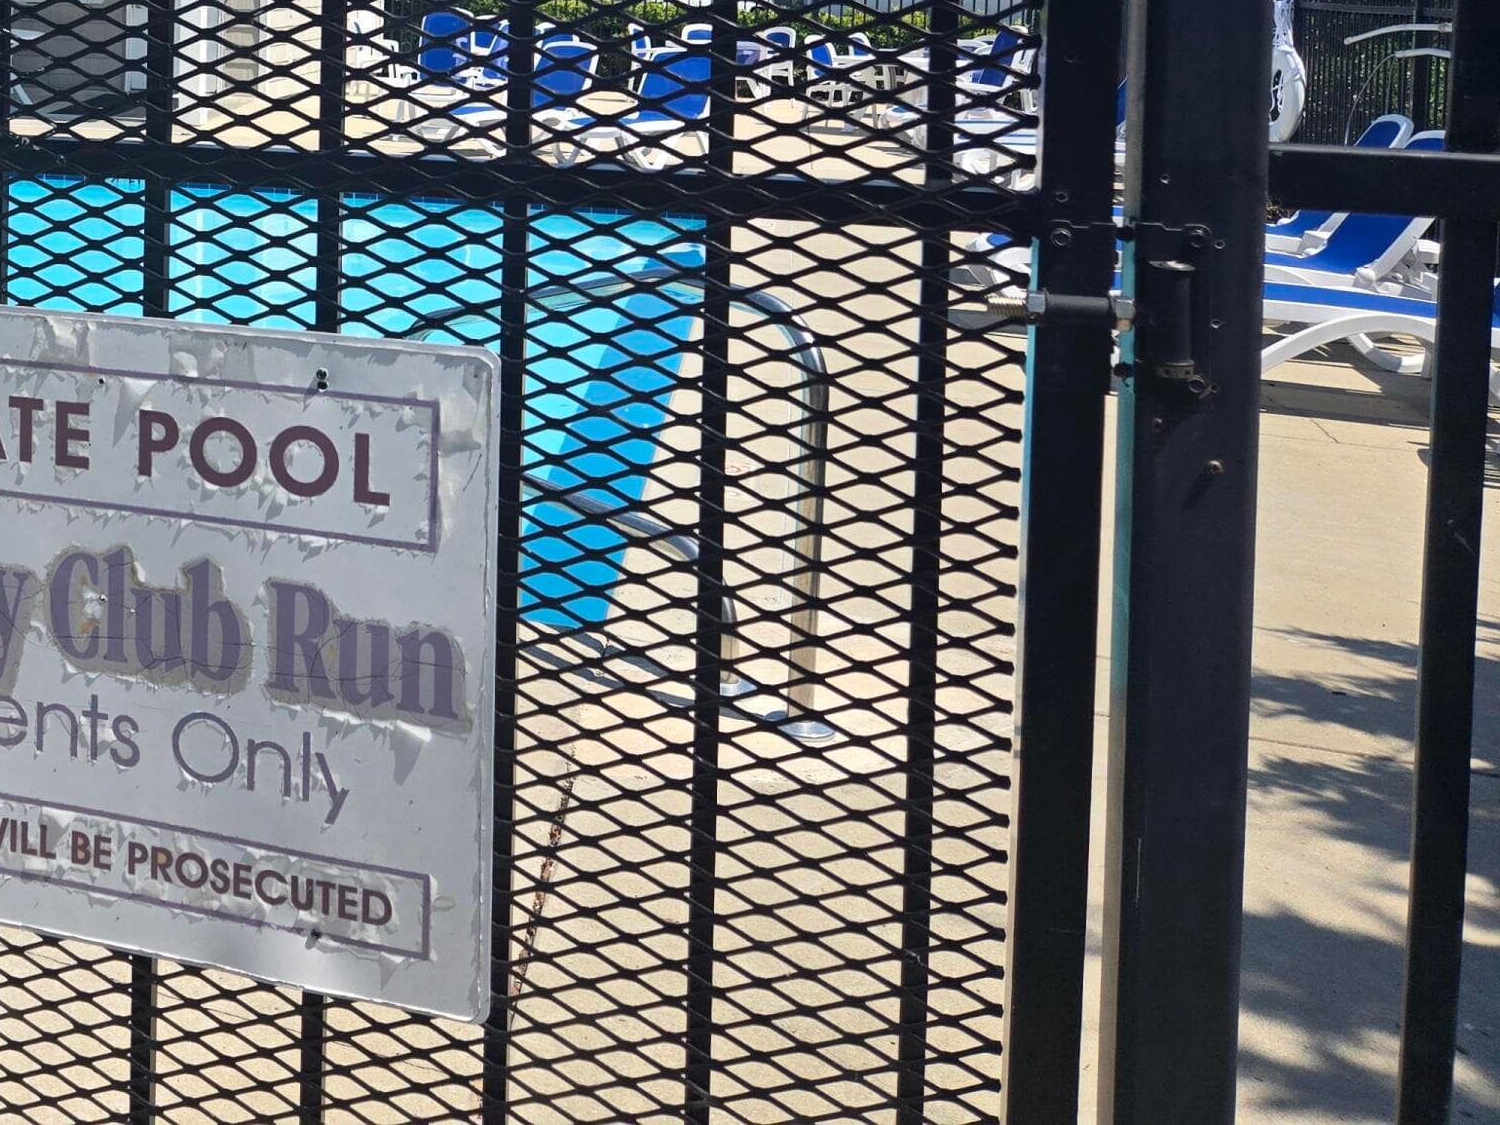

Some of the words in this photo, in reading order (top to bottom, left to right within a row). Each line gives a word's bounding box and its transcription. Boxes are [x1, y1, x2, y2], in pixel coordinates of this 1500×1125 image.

[138, 409, 390, 506] POOL
[50, 545, 242, 681] Club
[267, 578, 459, 719] Run
[172, 712, 350, 826] Only
[71, 830, 112, 871] BE
[128, 841, 393, 925] PROSECUTED
